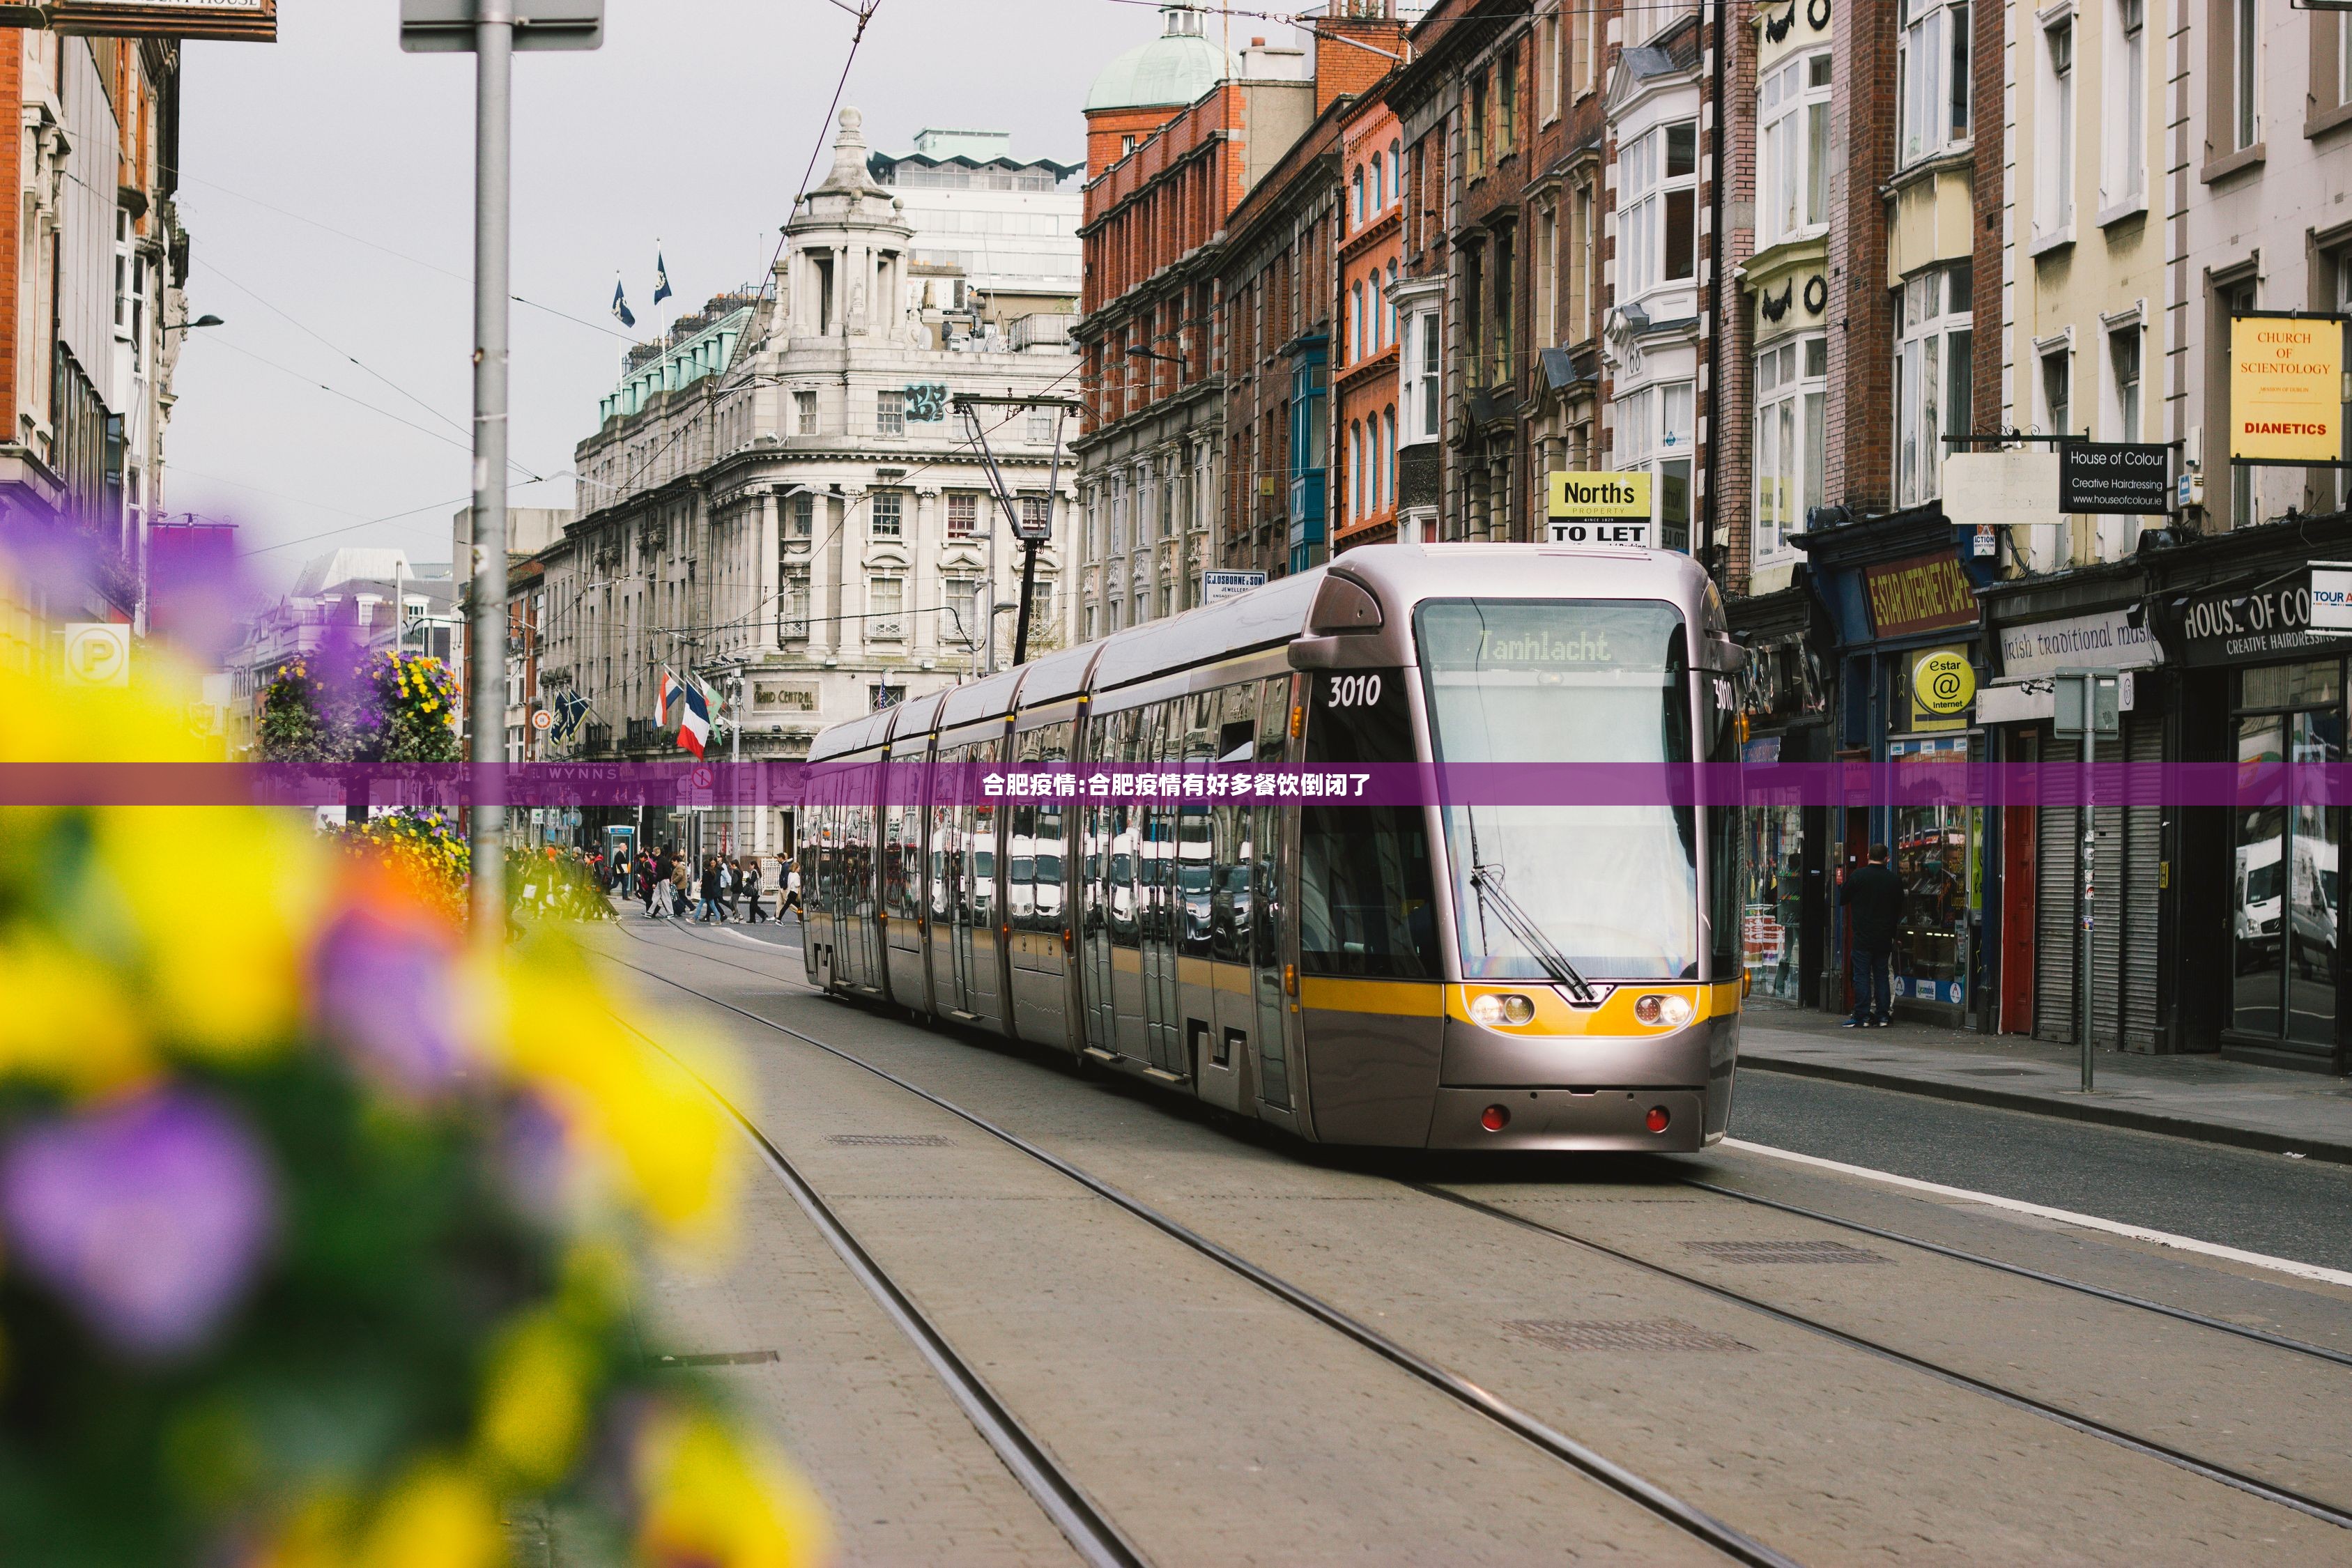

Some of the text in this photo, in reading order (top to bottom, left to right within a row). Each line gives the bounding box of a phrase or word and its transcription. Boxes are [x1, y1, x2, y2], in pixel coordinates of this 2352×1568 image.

[2257, 332, 2311, 344] CHURCH
[1629, 341, 1640, 374] 68
[2276, 348, 2293, 359] OF
[2240, 362, 2331, 375] SCIENTOLOGY
[2245, 422, 2326, 436] DIANETICS
[2070, 452, 2163, 466] House of Colour
[2072, 478, 2163, 492] Creative Hairdressing
[1565, 482, 1635, 504] Norths
[2073, 495, 2162, 506] www.houseofcolour.ie
[1552, 526, 1645, 541] TO LET
[1250, 576, 1263, 585] SON
[1899, 562, 1946, 622] INTERNET
[2313, 591, 2344, 603] TOUR
[2250, 593, 2275, 631] OF
[1479, 630, 1611, 661] Tamhlacht
[2038, 621, 2113, 656] traditional
[2226, 635, 2267, 655] CREATIVE
[82, 638, 115, 672] P
[1328, 674, 1381, 707] 3010
[1932, 672, 1960, 700] @
[1712, 679, 1733, 711] 3010
[1932, 700, 1963, 709] Internet
[548, 767, 617, 780] WYNNS
